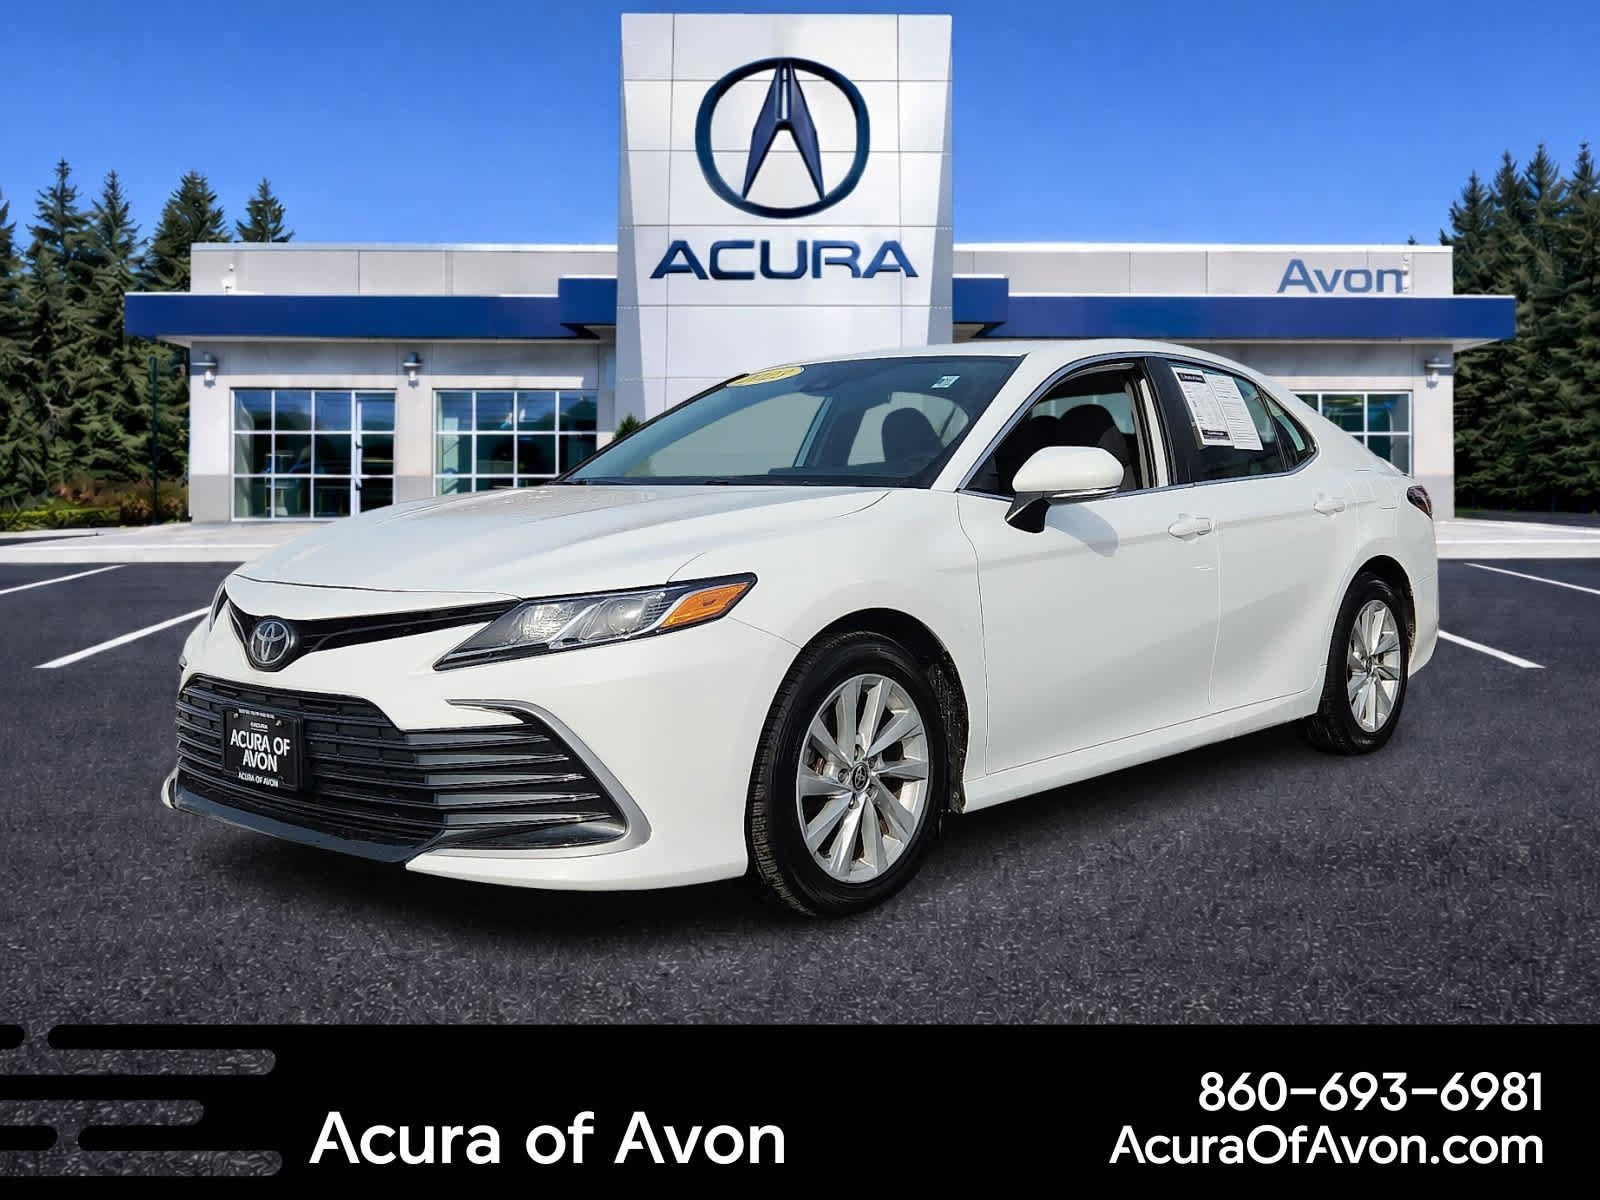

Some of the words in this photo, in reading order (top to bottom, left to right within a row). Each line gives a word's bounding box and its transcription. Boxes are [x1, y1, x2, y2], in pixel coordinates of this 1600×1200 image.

[649, 239, 920, 280] ACURA
[1276, 258, 1404, 294] Avon
[230, 728, 271, 753] ACURA
[273, 736, 291, 757] OF
[242, 749, 278, 773] AVON
[238, 771, 255, 782] ACURA
[255, 775, 263, 784] OF
[262, 777, 279, 788] AVON
